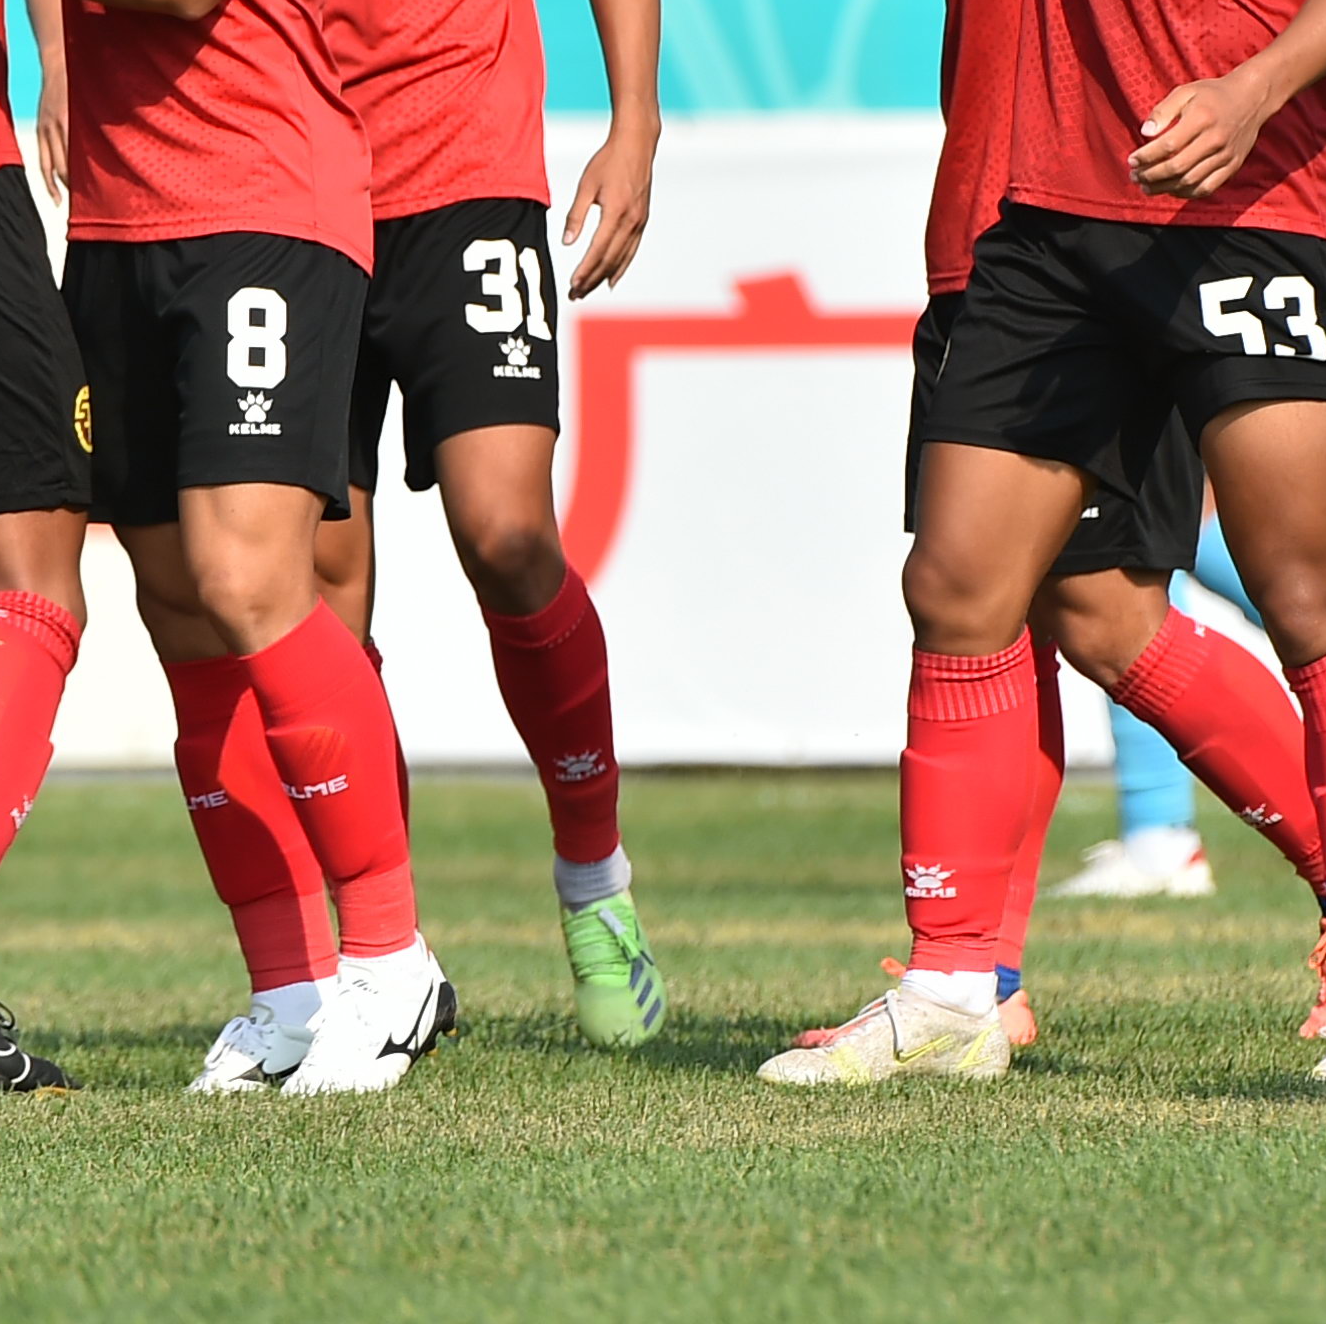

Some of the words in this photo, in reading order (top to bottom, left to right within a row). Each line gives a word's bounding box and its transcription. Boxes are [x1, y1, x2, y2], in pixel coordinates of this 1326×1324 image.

[462, 238, 553, 341] 31
[227, 287, 287, 389] 8
[493, 365, 541, 379] KELME
[228, 422, 282, 436] KELME
